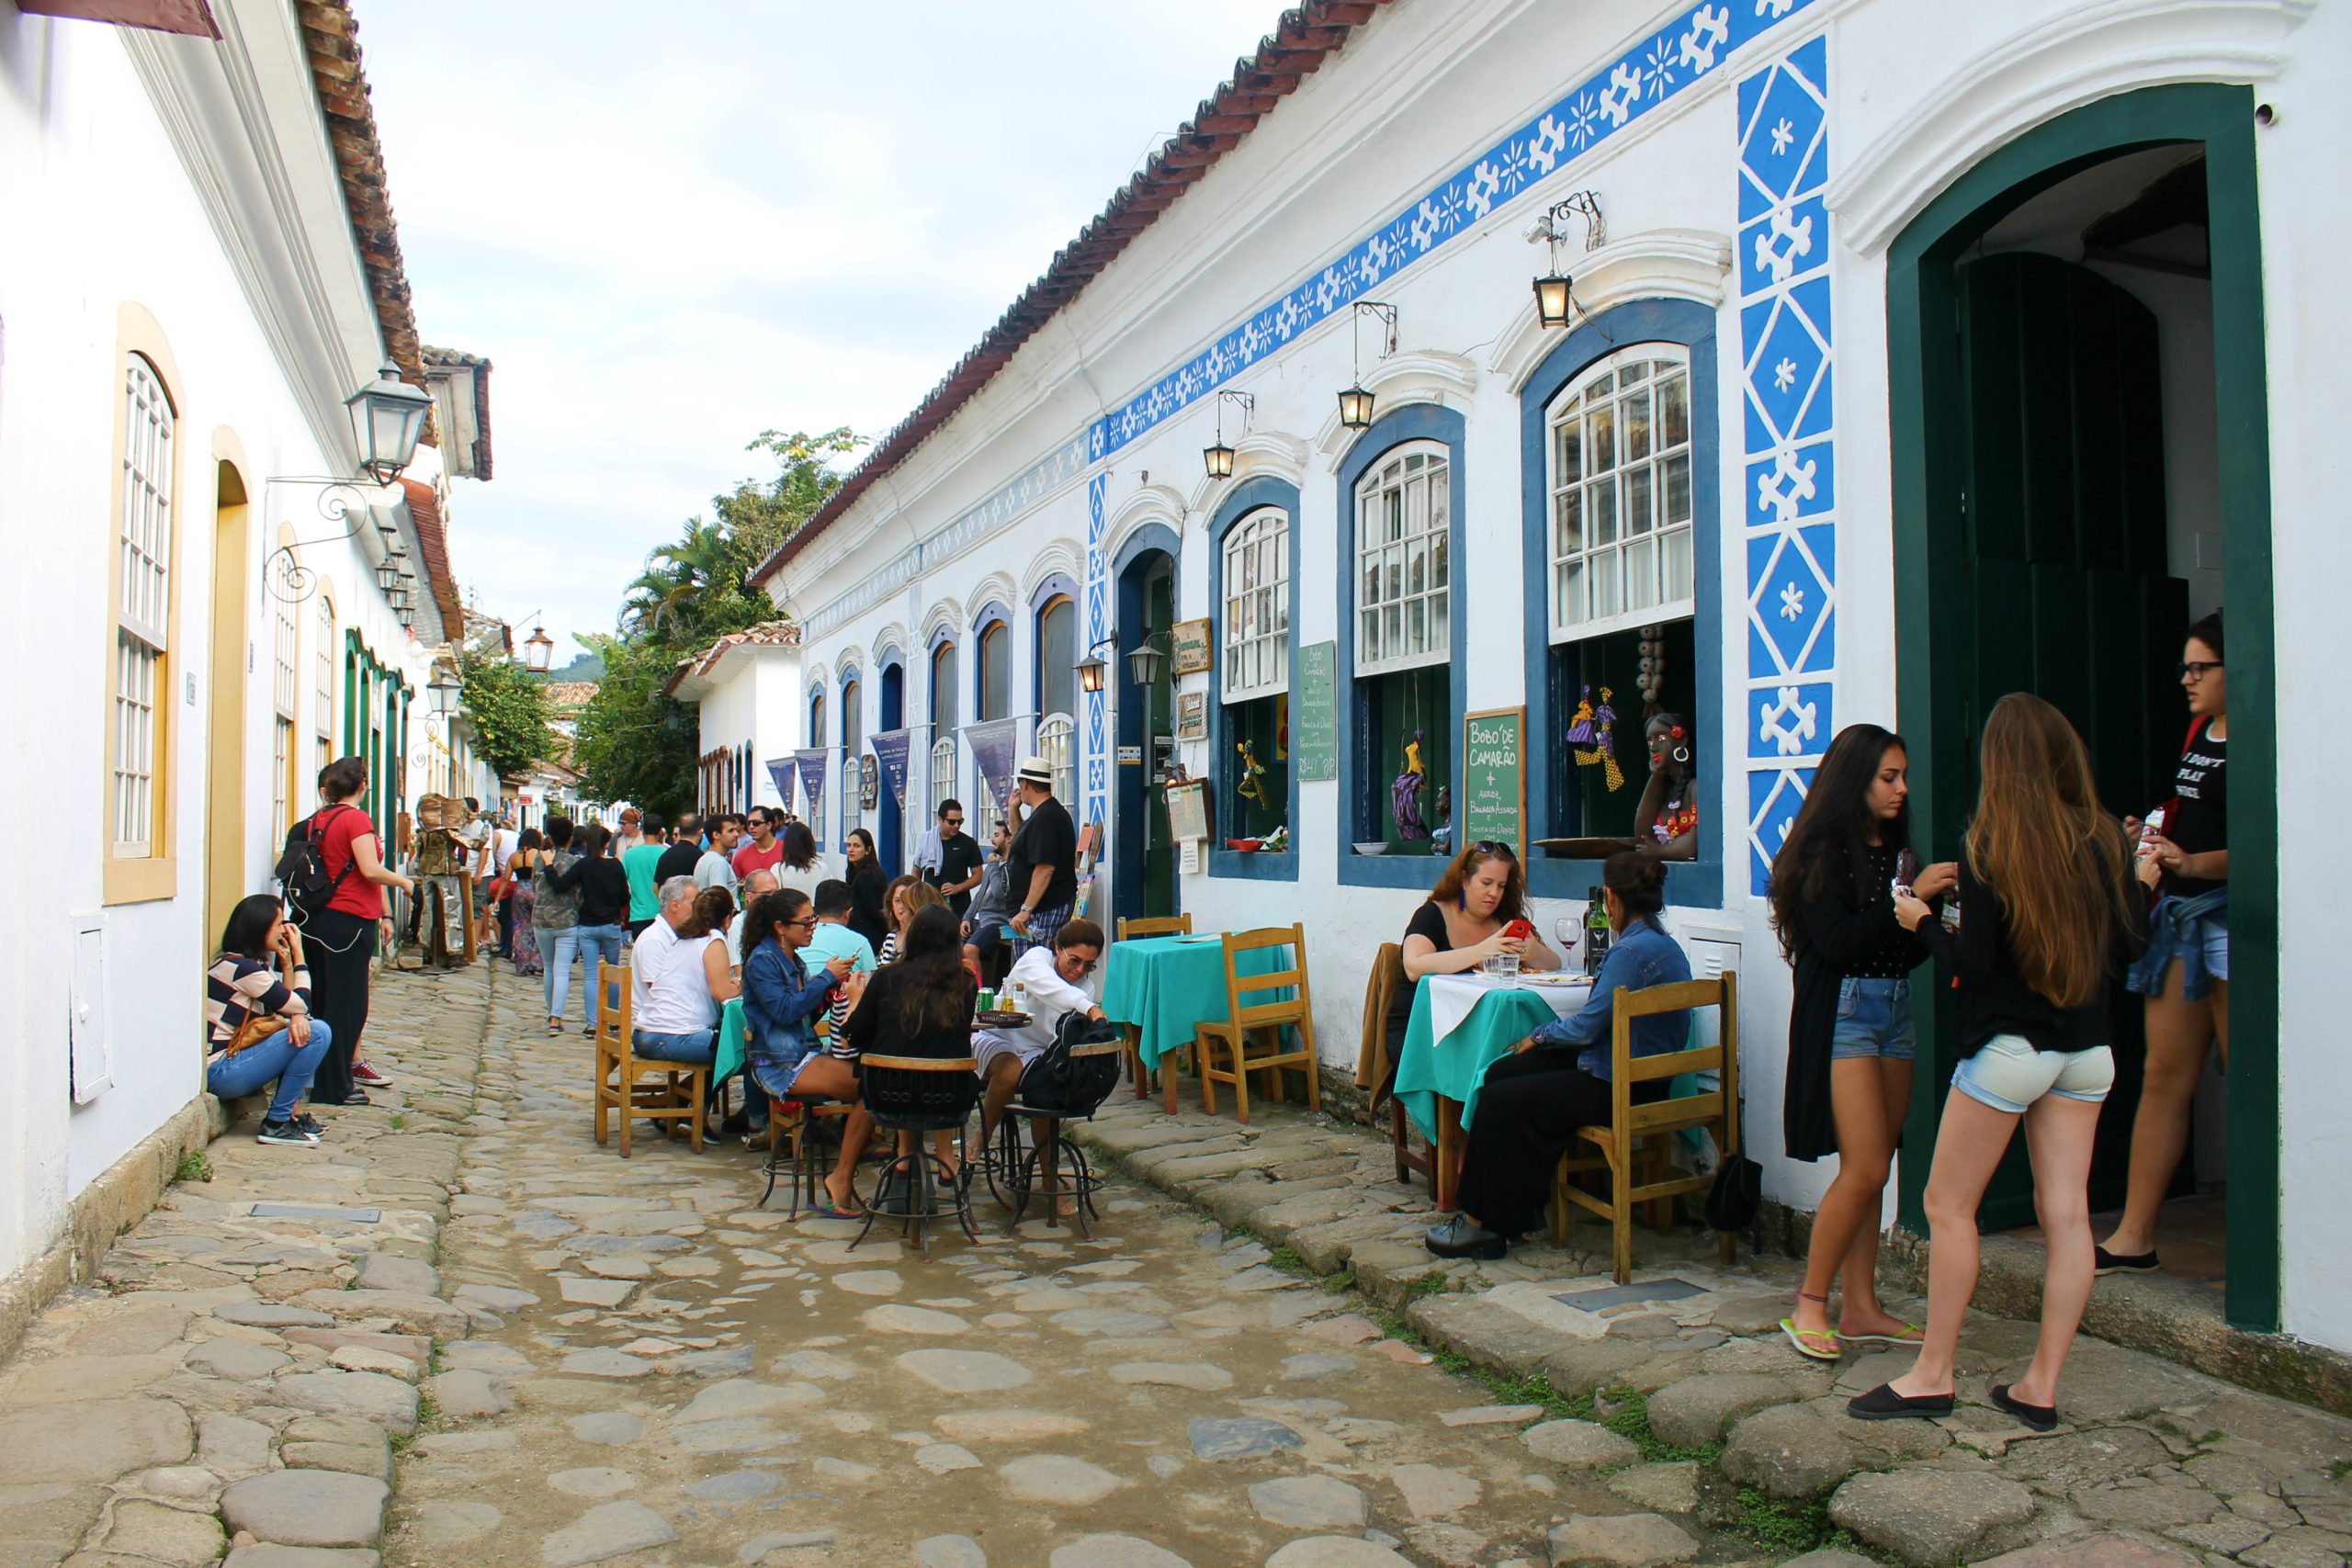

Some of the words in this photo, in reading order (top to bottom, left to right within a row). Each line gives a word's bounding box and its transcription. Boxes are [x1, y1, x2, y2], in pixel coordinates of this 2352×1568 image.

[1502, 728, 1514, 744] DE
[1470, 745, 1516, 768] CAMARÃO
[2182, 752, 2192, 761] I
[2188, 754, 2226, 767] DON'T
[2177, 768, 2206, 782] PLAY
